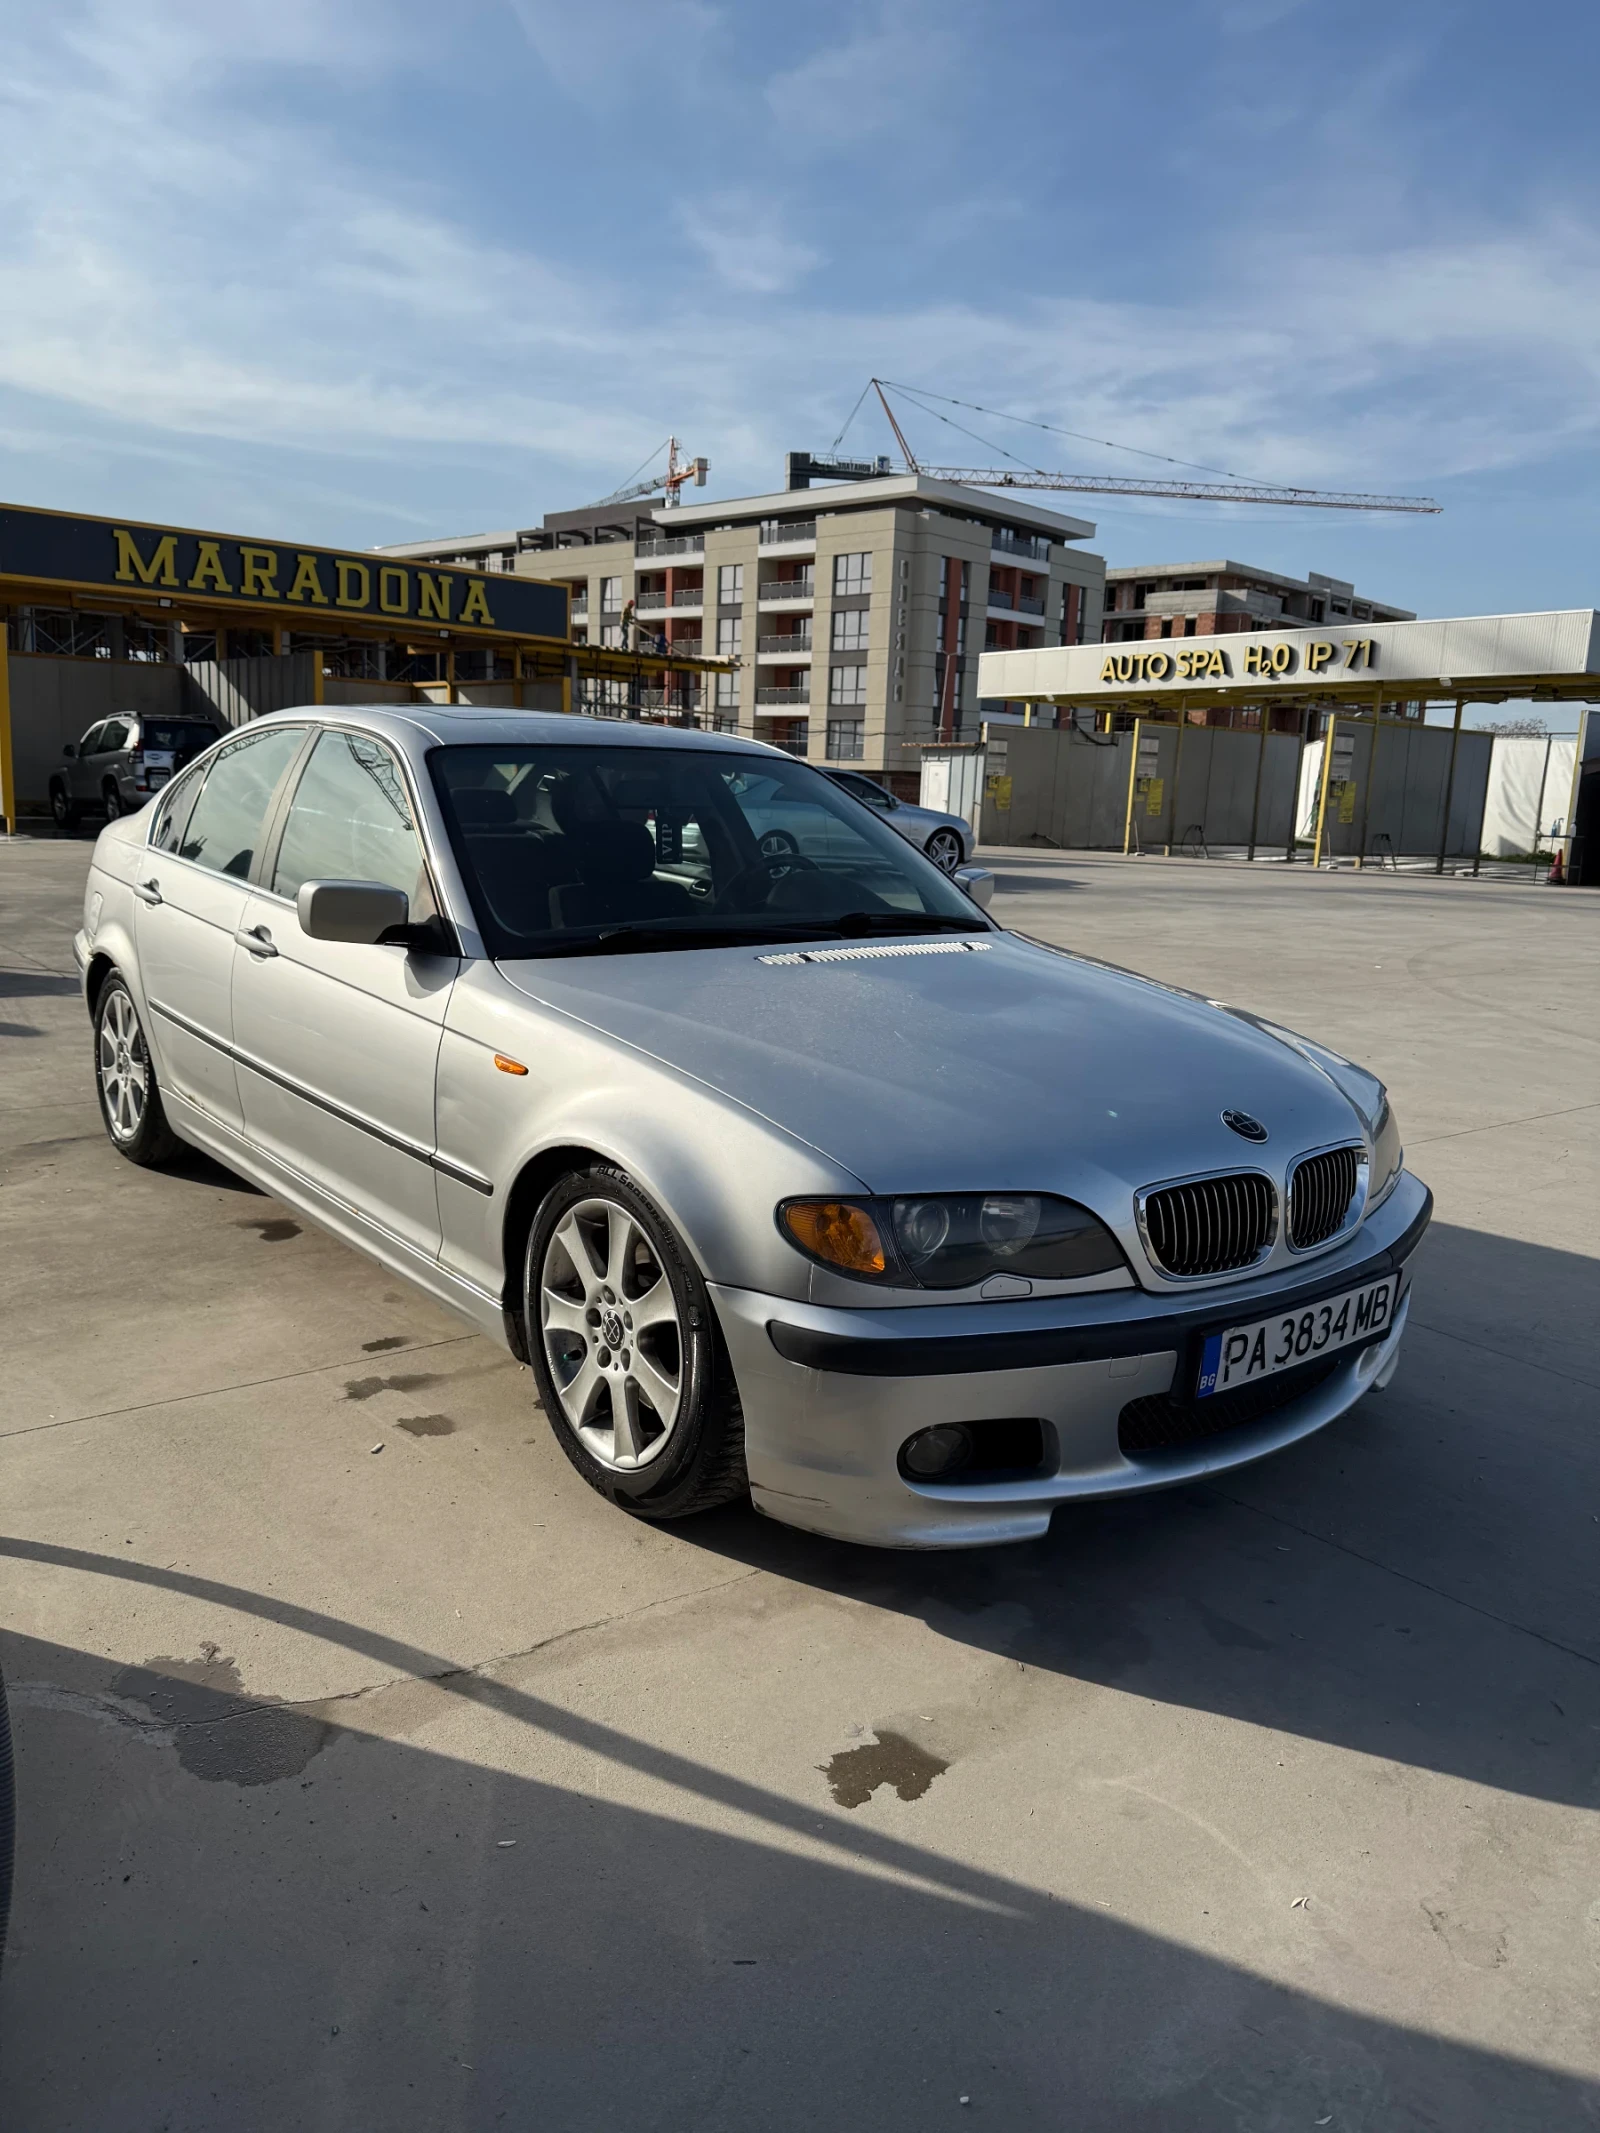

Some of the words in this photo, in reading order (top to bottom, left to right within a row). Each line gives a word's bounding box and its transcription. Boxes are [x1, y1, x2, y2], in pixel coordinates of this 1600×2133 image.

[113, 529, 495, 625] MARADONA
[1099, 652, 1168, 681] AUTO
[1174, 648, 1226, 677] SPA
[1304, 641, 1333, 671] IP
[1343, 639, 1372, 668] 71
[662, 823, 673, 855] VIP
[1222, 1327, 1266, 1383] PA
[1274, 1298, 1351, 1364] 3834
[1352, 1284, 1390, 1336] MB
[1200, 1373, 1215, 1390] BG
